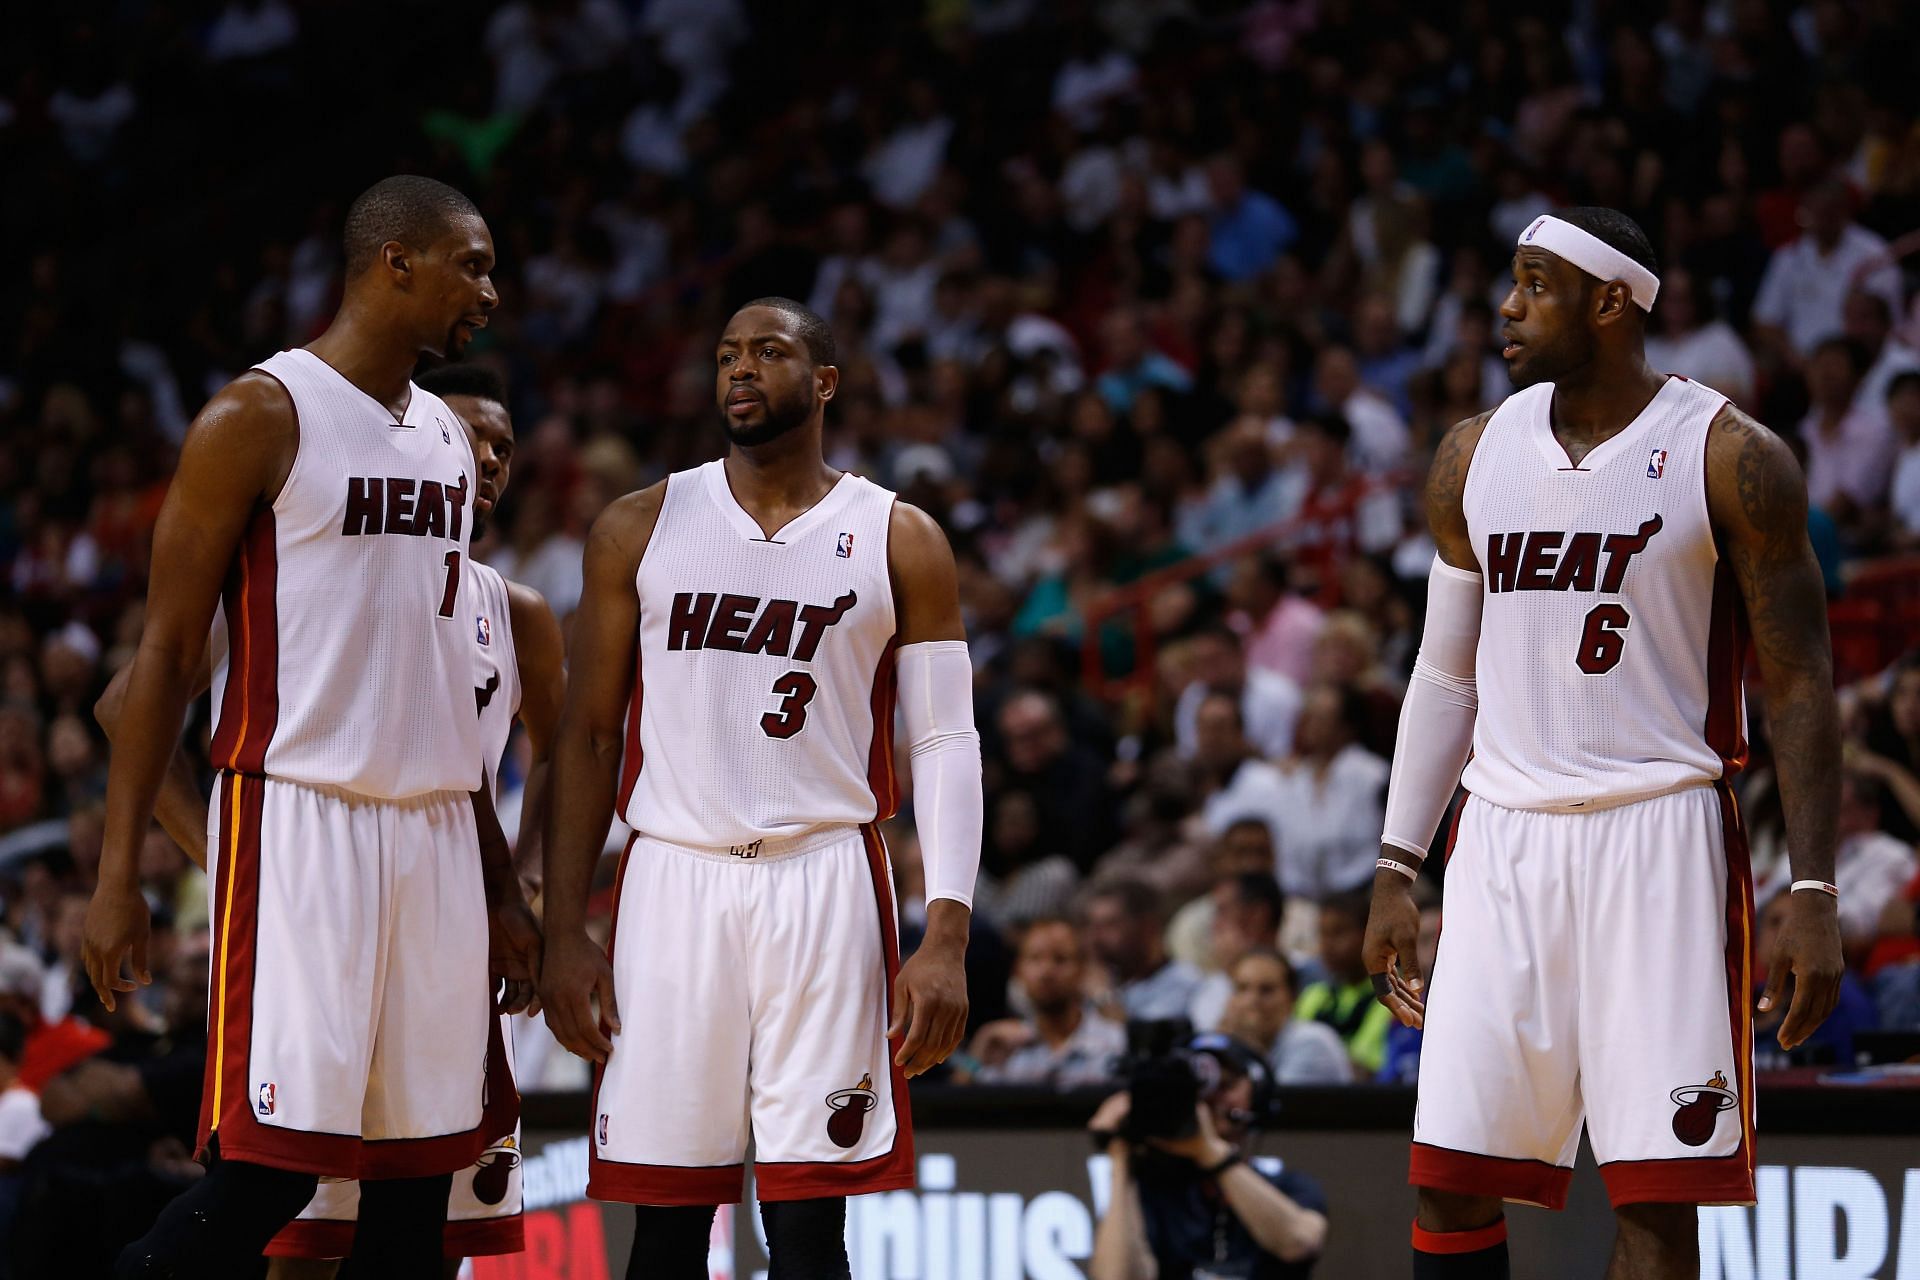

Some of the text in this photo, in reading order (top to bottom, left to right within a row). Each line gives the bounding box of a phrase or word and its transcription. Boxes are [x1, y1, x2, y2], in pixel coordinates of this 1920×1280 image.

[342, 470, 467, 542] HEAT
[437, 550, 460, 619] 1
[1487, 513, 1663, 593] HEAT
[667, 589, 857, 662] HEAT
[1575, 603, 1632, 676] 6
[759, 670, 818, 740] 3
[752, 1153, 1093, 1280] rius
